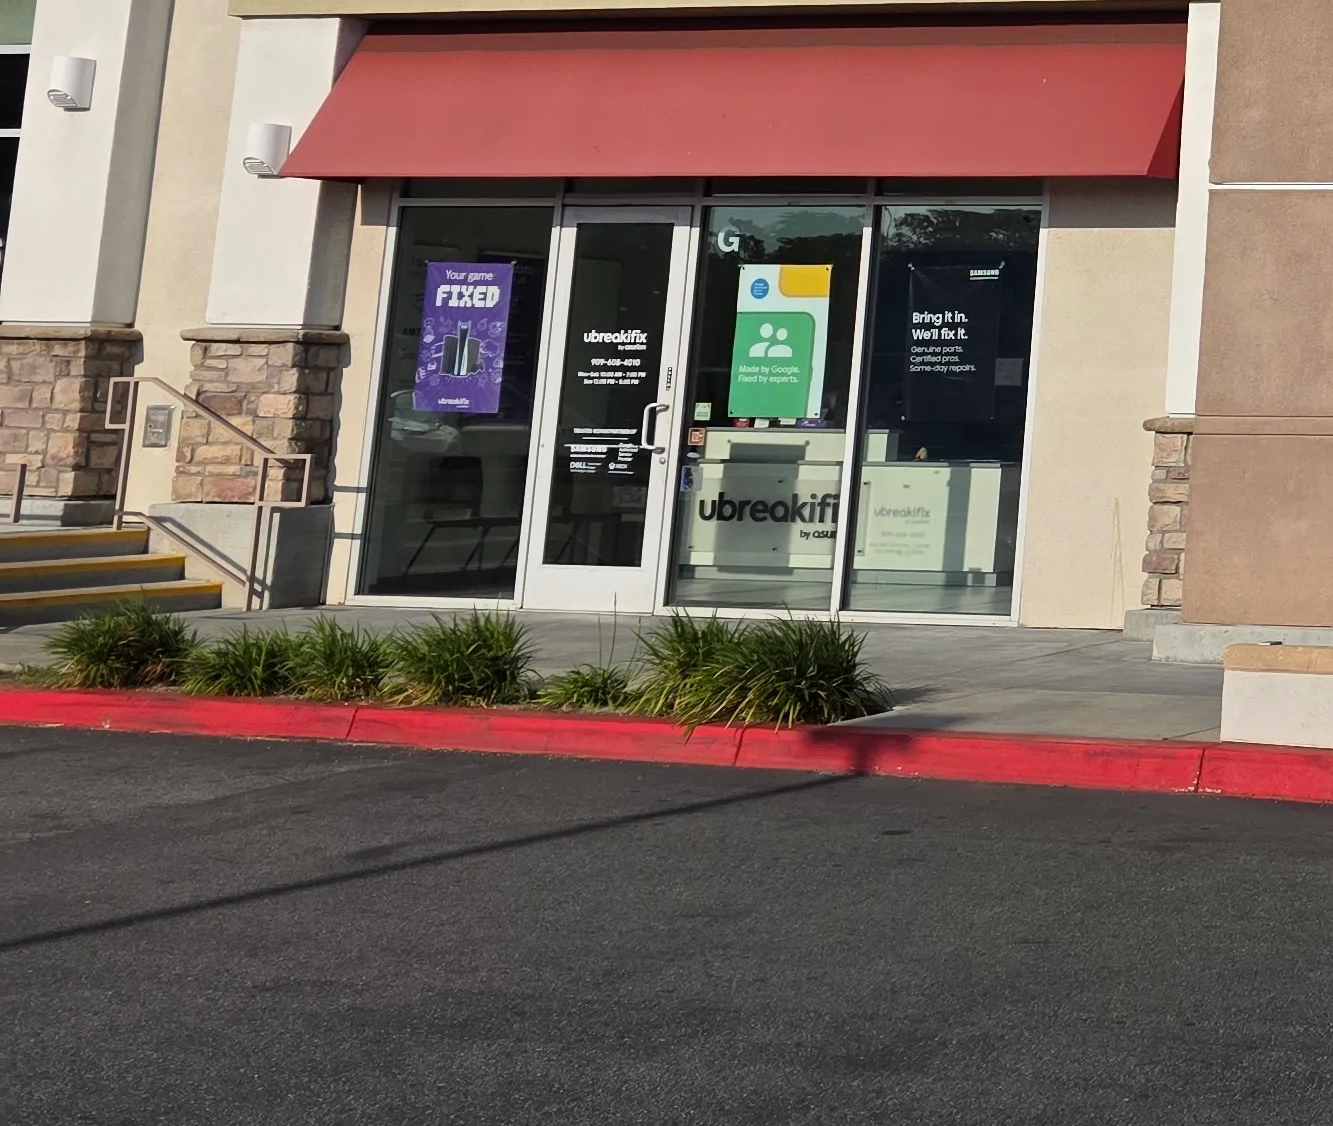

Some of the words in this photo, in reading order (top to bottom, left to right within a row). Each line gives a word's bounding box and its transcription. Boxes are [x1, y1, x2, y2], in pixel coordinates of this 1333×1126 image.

[718, 225, 740, 252] G
[445, 270, 466, 280] Your
[468, 273, 493, 282] game
[435, 285, 500, 307] FIXED
[912, 311, 942, 326] Bring
[944, 311, 952, 322] it
[954, 311, 968, 322] in.
[583, 330, 648, 343] ubreakifix
[912, 328, 938, 340] We'll
[941, 328, 955, 340] fix
[957, 327, 968, 339] it.
[942, 345, 963, 354] parts.
[738, 365, 759, 373] Made
[762, 365, 770, 374] by
[771, 365, 800, 374] Google.
[909, 365, 948, 373] Same-day
[949, 364, 976, 373] repairs.
[738, 375, 757, 383] Fixed
[759, 375, 767, 384] by
[769, 375, 799, 384] experts.
[699, 492, 840, 523] ubreakifi
[800, 530, 810, 540] by
